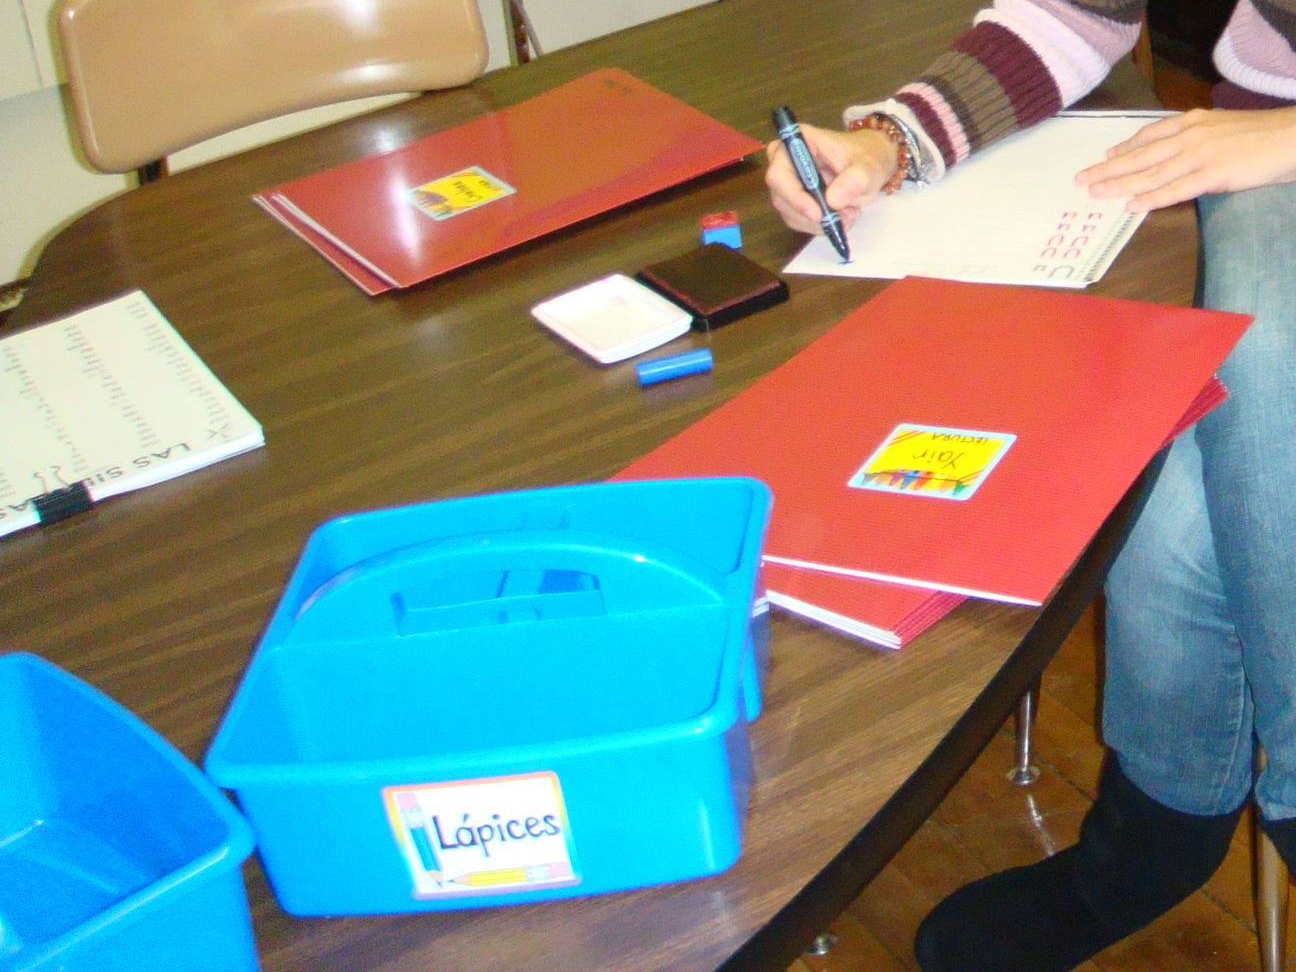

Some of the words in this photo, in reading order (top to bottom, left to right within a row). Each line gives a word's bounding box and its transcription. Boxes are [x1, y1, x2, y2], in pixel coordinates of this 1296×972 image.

[931, 432, 989, 446] LECTURA
[132, 441, 192, 469] LAS
[912, 449, 965, 470] Yair
[432, 812, 561, 858] Lápices
